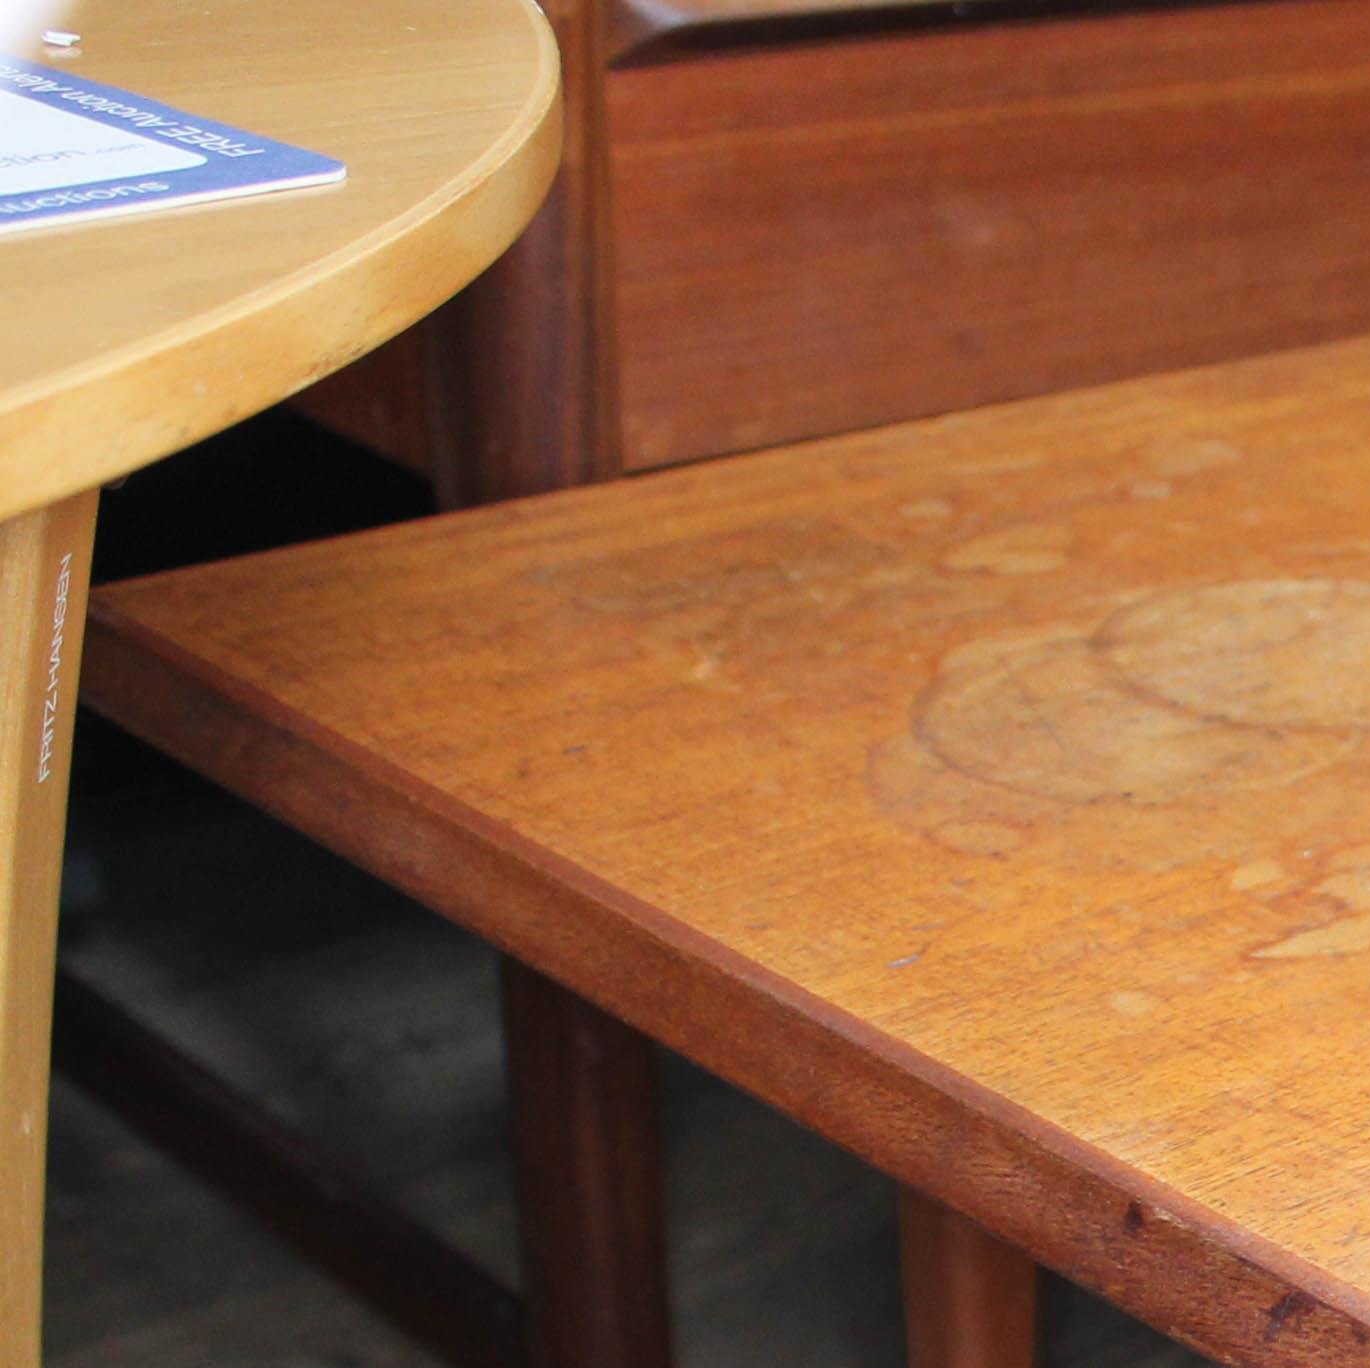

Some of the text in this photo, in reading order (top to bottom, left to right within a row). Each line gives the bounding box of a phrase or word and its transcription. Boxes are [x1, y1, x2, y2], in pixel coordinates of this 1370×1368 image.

[62, 89, 165, 127] Auction
[157, 122, 265, 158] FREE
[0, 181, 171, 214] uctions
[37, 552, 73, 784] FRITZ HANSEN
